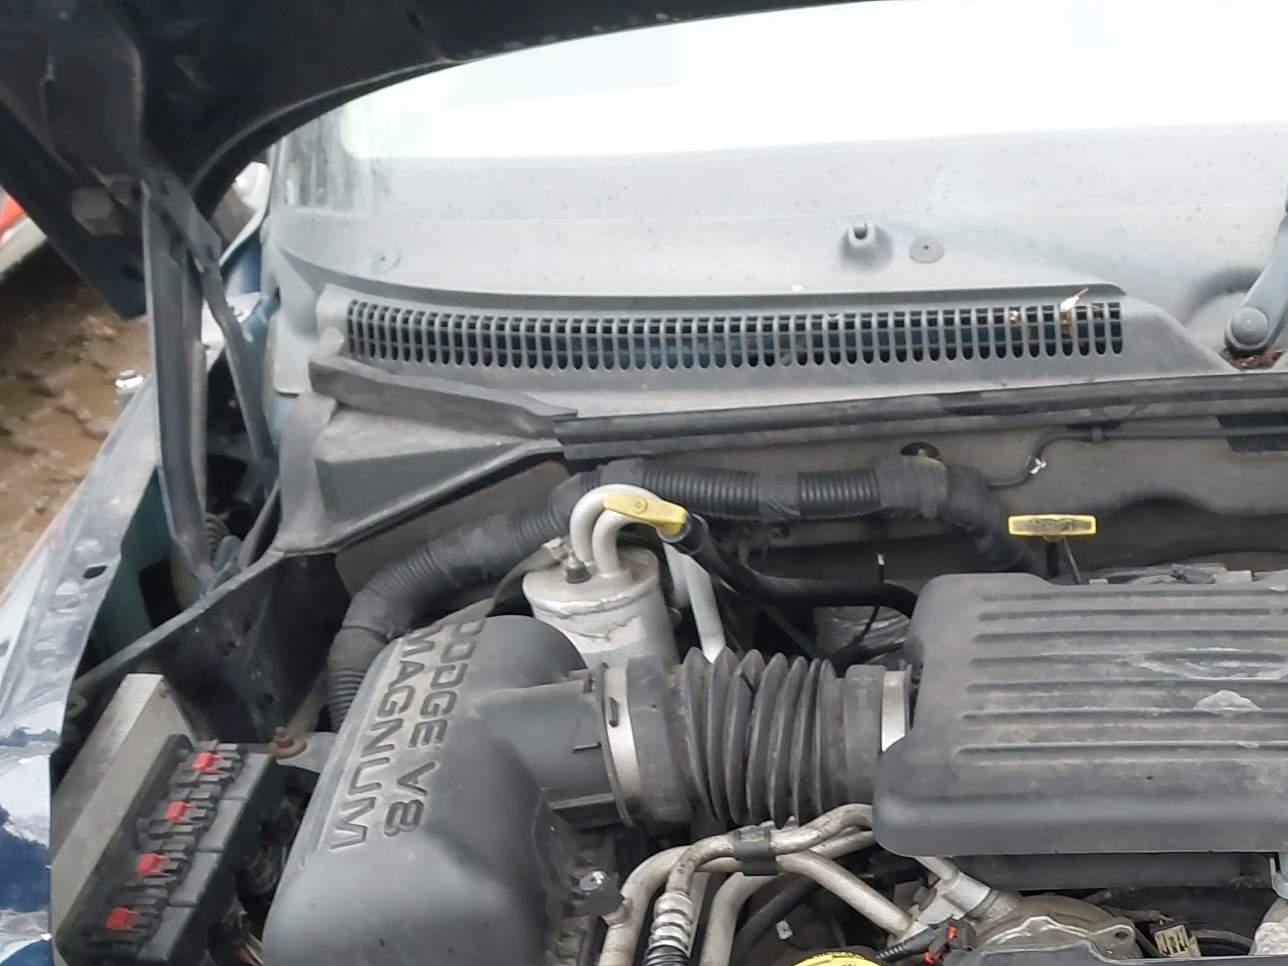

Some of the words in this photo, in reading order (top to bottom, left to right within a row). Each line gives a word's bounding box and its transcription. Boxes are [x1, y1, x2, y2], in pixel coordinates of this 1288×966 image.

[328, 624, 445, 851] MAGNUM
[408, 616, 487, 749] DODGE
[384, 761, 437, 838] V8
